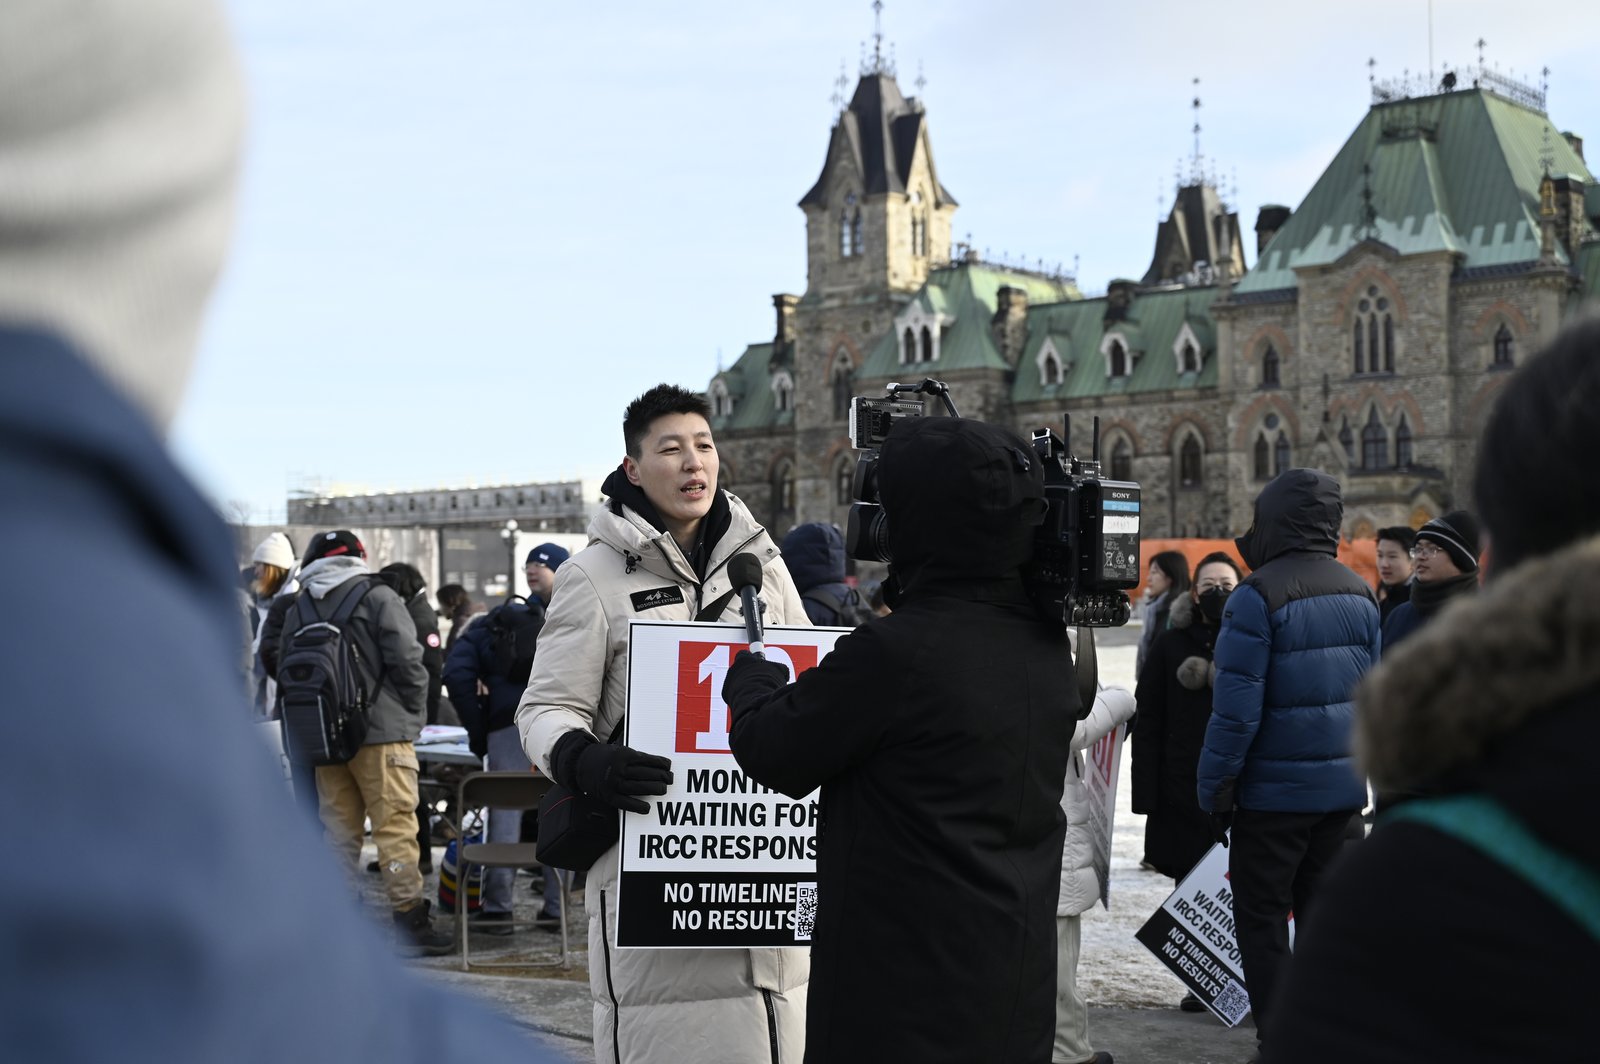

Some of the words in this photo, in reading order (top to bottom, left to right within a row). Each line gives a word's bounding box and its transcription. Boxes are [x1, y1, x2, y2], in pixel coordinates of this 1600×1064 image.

[696, 645, 797, 749] 1
[687, 769, 779, 794] MON
[657, 802, 767, 827] WAITING
[638, 834, 697, 859] IRCC
[664, 883, 694, 903] NO
[699, 883, 796, 903] TIMELINE
[672, 910, 701, 930] NO
[708, 910, 796, 930] RESULTS
[1173, 898, 1203, 927] IRCC
[1168, 926, 1185, 945] NO
[1183, 939, 1229, 987] TIMELINE
[1162, 941, 1179, 960] NO
[1176, 956, 1221, 998] RESULTS
